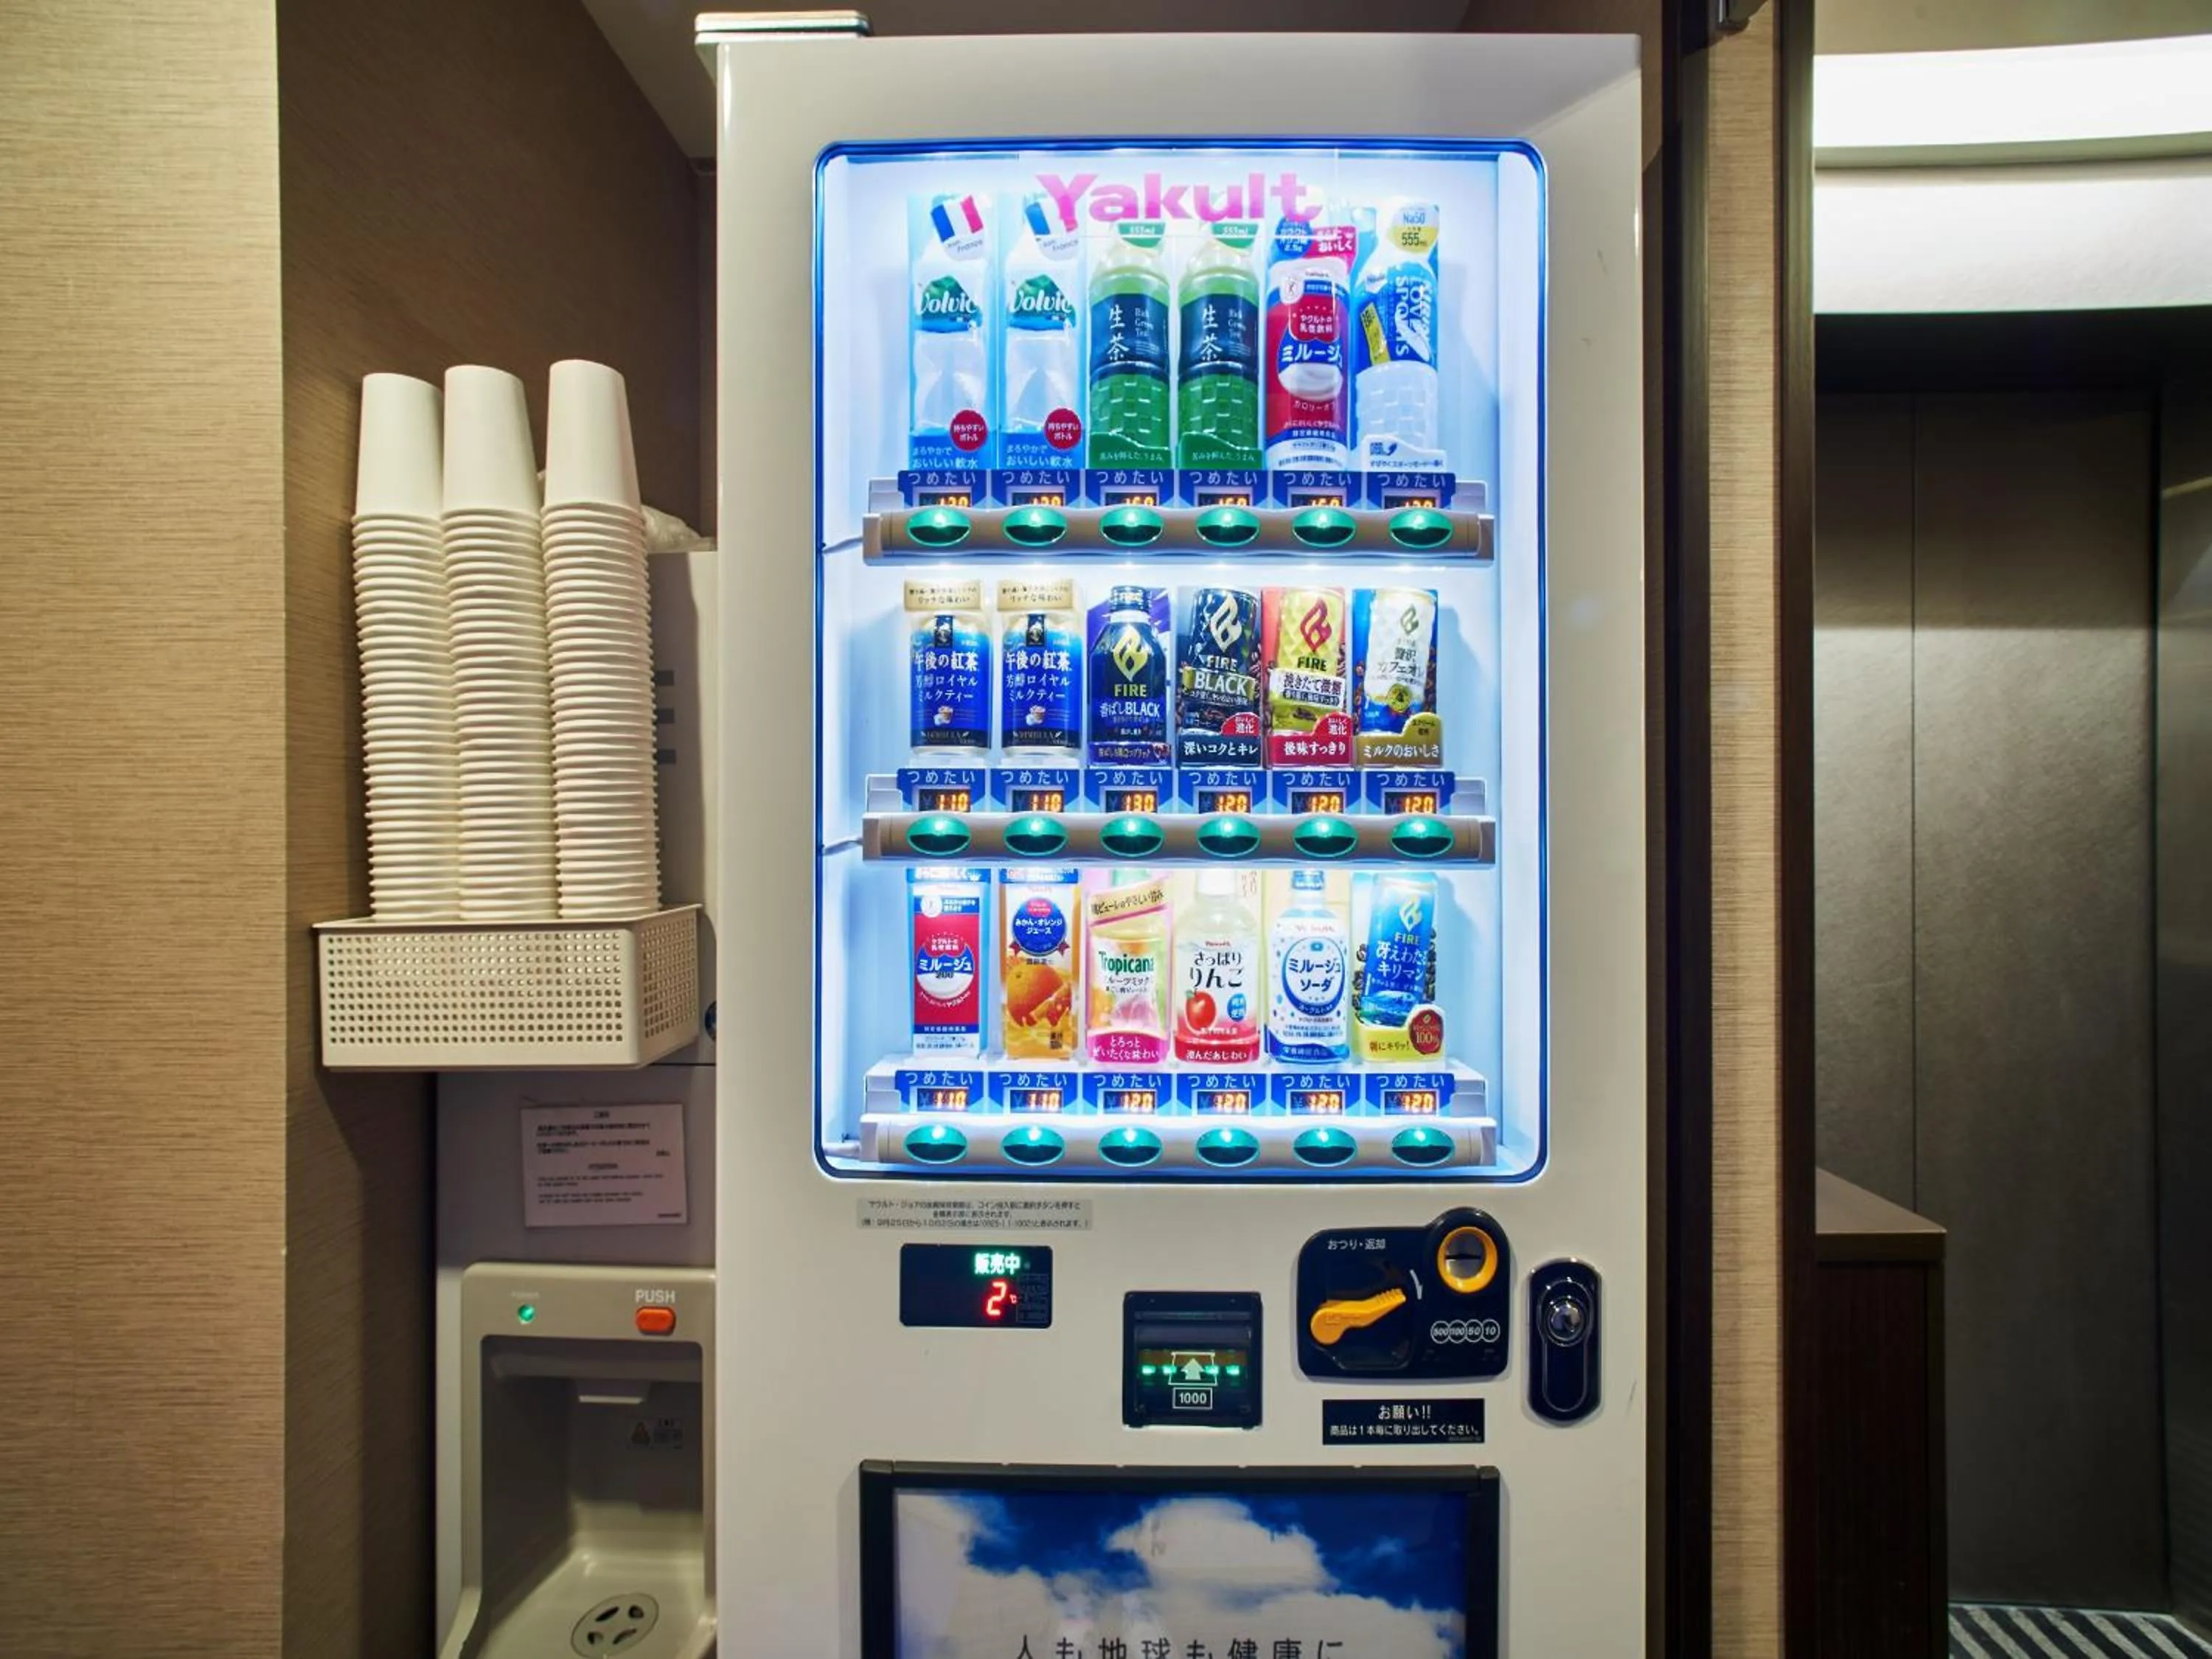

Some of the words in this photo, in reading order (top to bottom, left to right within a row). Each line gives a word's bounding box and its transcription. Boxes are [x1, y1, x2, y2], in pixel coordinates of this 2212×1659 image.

[1036, 173, 1324, 222] Yakult
[1107, 305, 1130, 361] 生茶
[1200, 305, 1223, 361] 生茶
[908, 472, 975, 485] つめたい
[1002, 472, 1069, 484] つめたい
[1097, 472, 1164, 484] つめたい
[1190, 472, 1257, 485] つめたい
[1284, 473, 1352, 485] つめたい
[1378, 473, 1446, 487] つめたい
[915, 651, 978, 671] 午後の紅茶
[1006, 650, 1072, 671] 午後の紅茶
[1206, 655, 1237, 672] FIRE
[1297, 656, 1327, 672] FIRE
[1114, 684, 1147, 696] FIRE
[1194, 671, 1248, 696] BLACK
[1009, 689, 1065, 701] ミルクティー
[1184, 741, 1259, 757] 深いコクとキレ
[1284, 741, 1346, 756] 後味すっきり
[1364, 744, 1439, 758] ミルクのおいしさ
[908, 771, 975, 784] つめたい
[1001, 771, 1068, 784] つめたい
[1096, 771, 1163, 785] つめたい
[1189, 772, 1257, 785] つめたい
[1283, 773, 1351, 785] つめたい
[1377, 773, 1445, 786] つめたい
[938, 793, 967, 811] 110
[1032, 793, 1061, 811] 110
[1217, 794, 1247, 812] 120
[1311, 796, 1340, 813] 120
[1404, 796, 1433, 813] 120
[1394, 932, 1420, 945] FIRE
[919, 956, 973, 971] ミルージュ
[1194, 951, 1242, 966] さっぱり
[1190, 968, 1243, 989] りんご
[1300, 976, 1333, 992] ソーダ
[906, 1072, 973, 1085] つめたい
[1000, 1073, 1067, 1086] つめたい
[1094, 1074, 1161, 1087] つめたい
[1188, 1074, 1256, 1088] つめたい
[1282, 1074, 1350, 1088] つめたい
[1377, 1075, 1445, 1088] つめたい
[1327, 1239, 1386, 1250] おつり・返却
[974, 1253, 1021, 1274] 販売中
[635, 1289, 675, 1304] PUSH
[1485, 1326, 1496, 1335] 10
[1179, 1392, 1207, 1404] 1000
[1378, 1405, 1431, 1420] お願い!!
[1018, 1635, 1343, 1659] 人も地球も健康に
